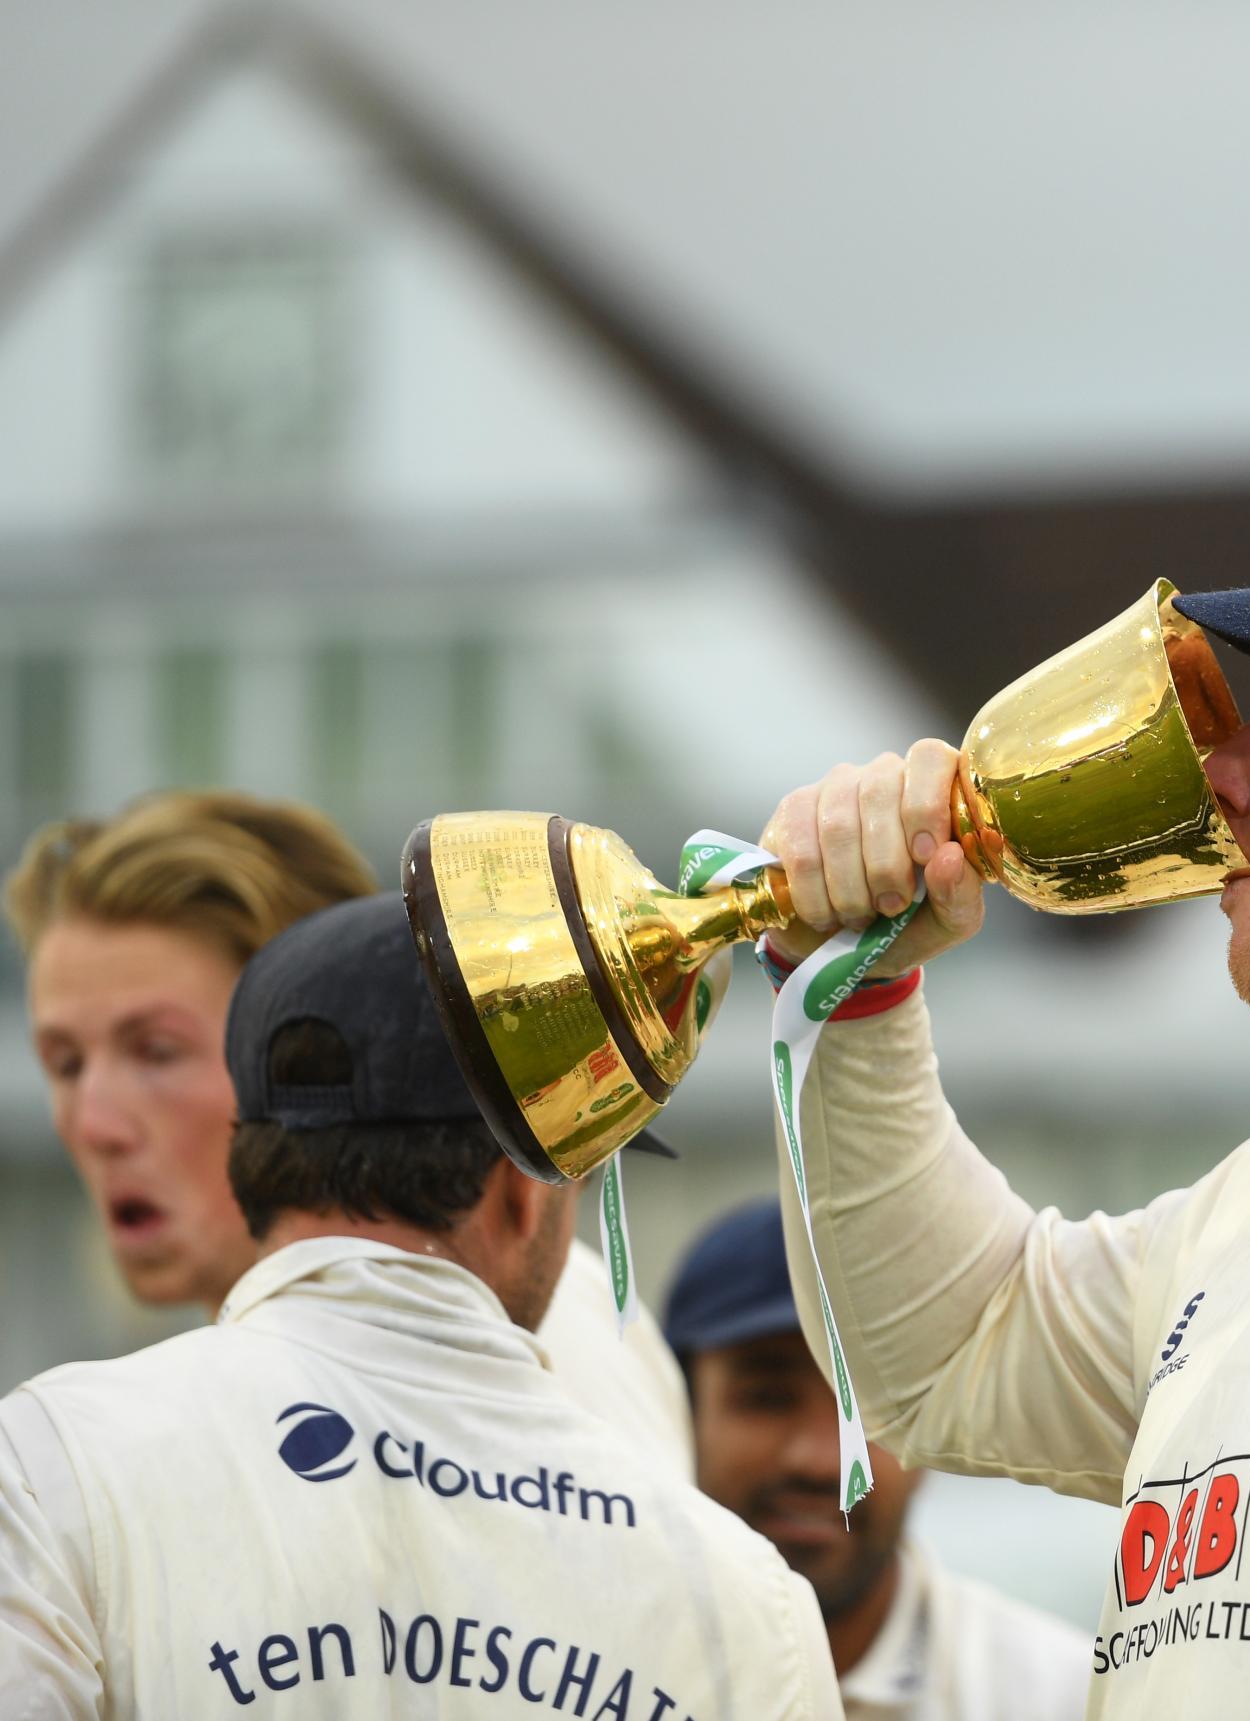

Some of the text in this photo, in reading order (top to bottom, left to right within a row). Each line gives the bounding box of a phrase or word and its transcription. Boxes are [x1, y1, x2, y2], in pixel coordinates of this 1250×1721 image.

[372, 1430, 637, 1529] Cloudfm
[1120, 1473, 1240, 1606] D&B
[208, 1607, 702, 1721] ten DOESCHAT
